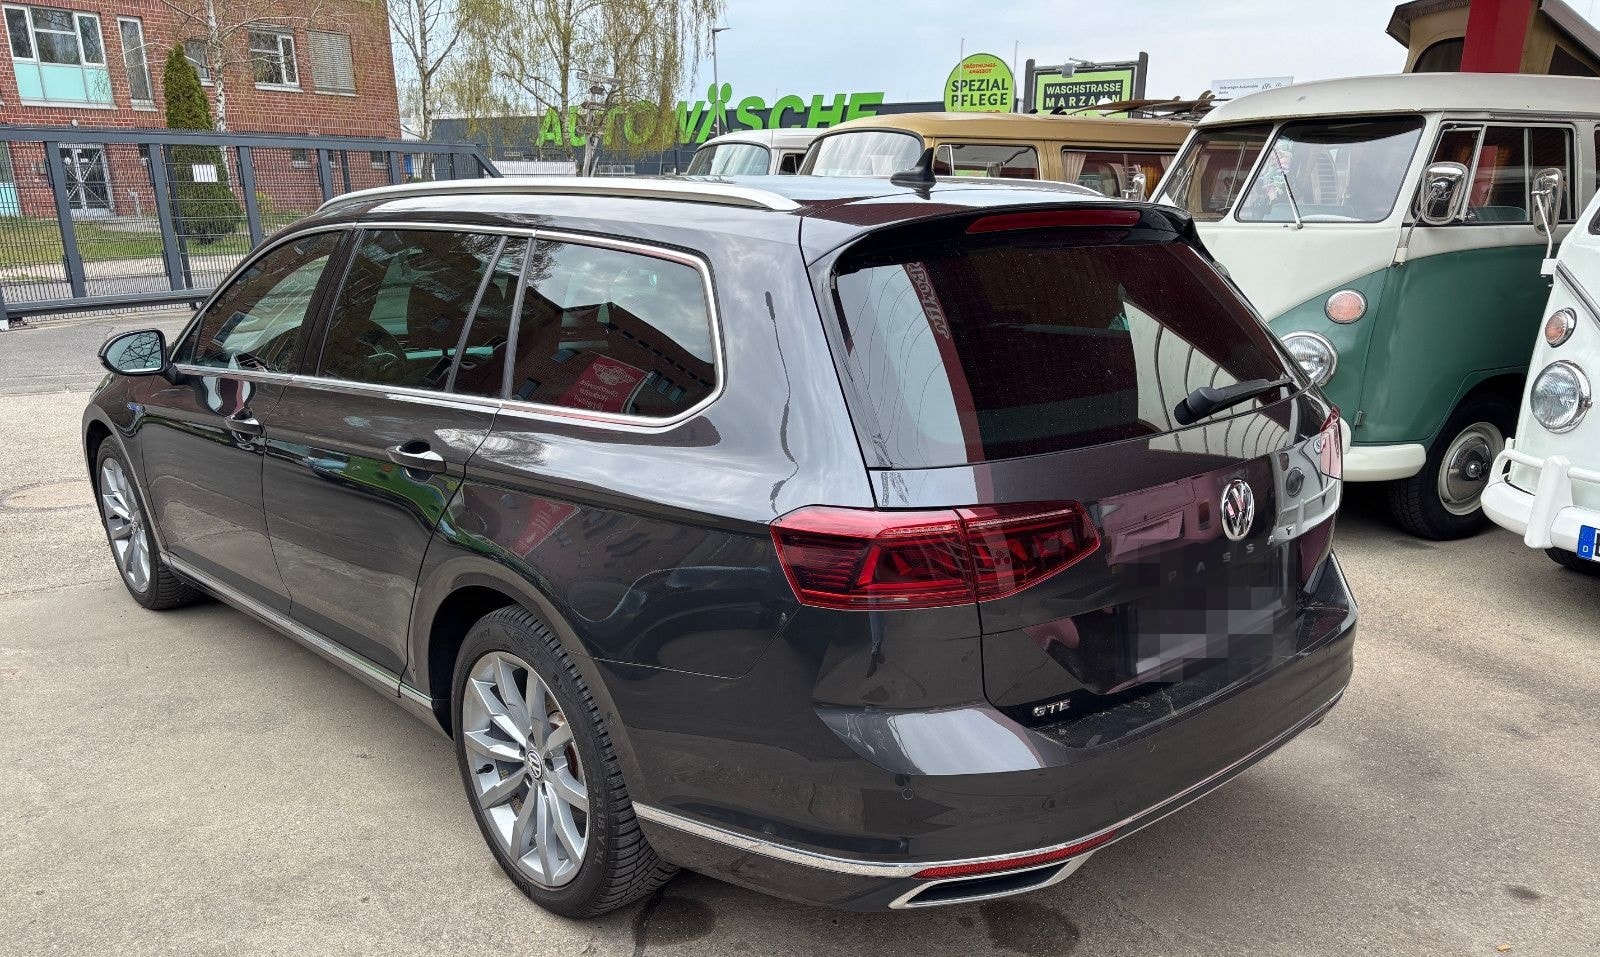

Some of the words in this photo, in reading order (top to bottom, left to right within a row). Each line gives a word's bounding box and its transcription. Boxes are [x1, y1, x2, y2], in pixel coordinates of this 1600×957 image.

[951, 78, 1008, 92] SPEZIAL
[1046, 83, 1121, 94] WASCHSTRASSE
[951, 93, 1008, 106] PFLEGE
[1032, 699, 1071, 717] GTE
